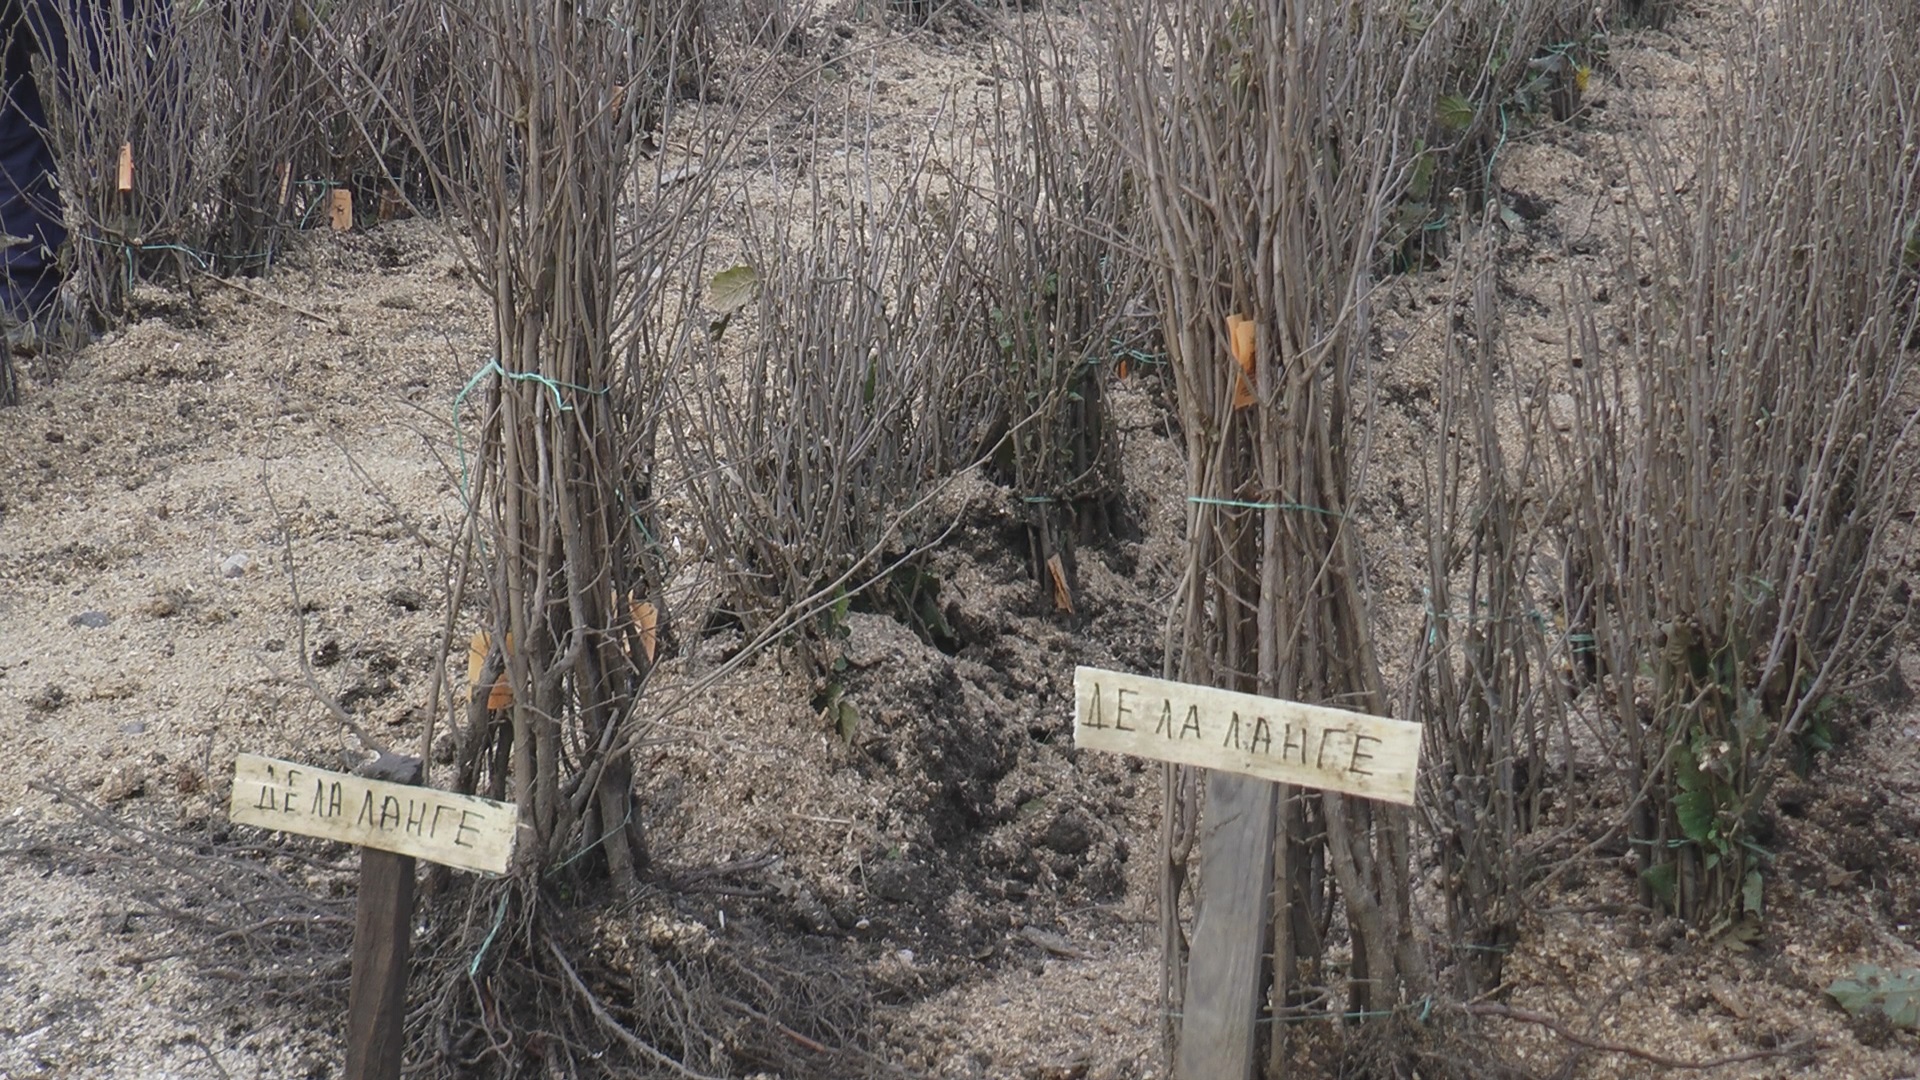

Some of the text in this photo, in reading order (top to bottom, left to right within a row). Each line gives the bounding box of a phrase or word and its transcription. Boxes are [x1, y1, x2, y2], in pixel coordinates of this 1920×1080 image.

[1081, 682, 1383, 776] ДЕ ЛА ЛАНГЕ
[253, 764, 486, 848] ДЕ ЛА ЛАНГЕ
